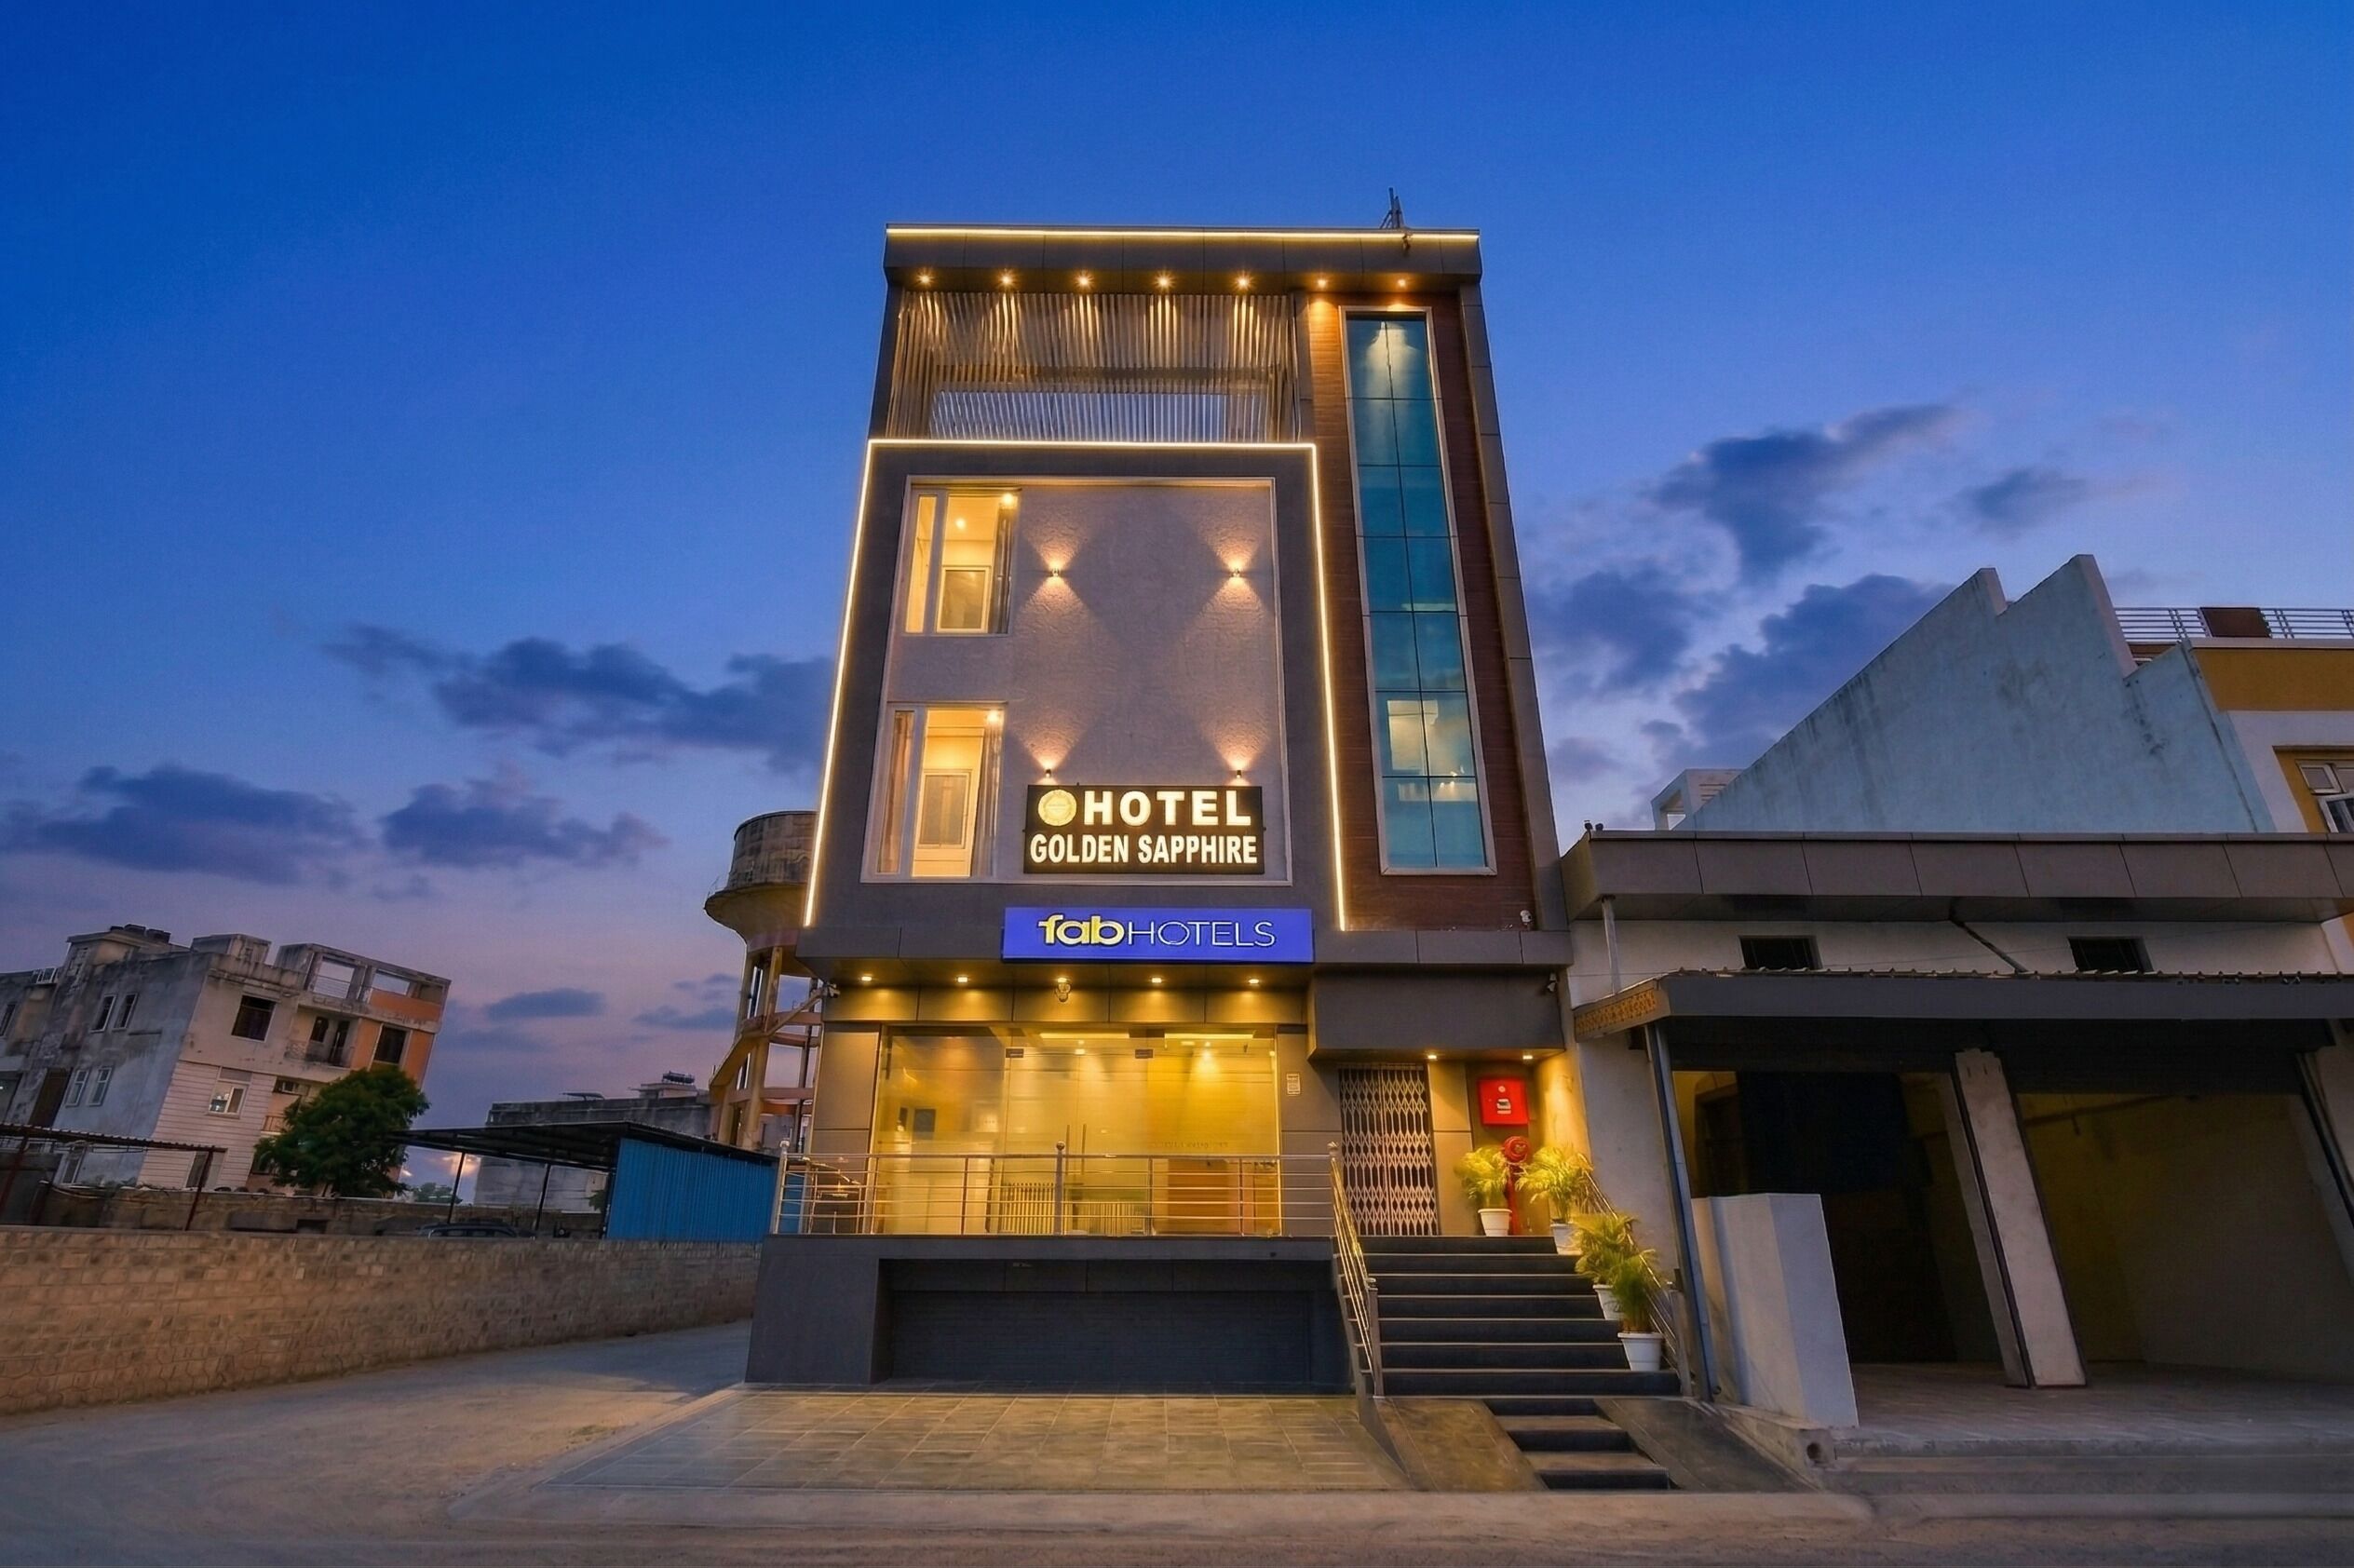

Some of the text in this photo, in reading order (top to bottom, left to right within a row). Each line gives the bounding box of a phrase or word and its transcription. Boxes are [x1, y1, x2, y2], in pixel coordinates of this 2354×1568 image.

[1083, 790, 1251, 827] HOTEL
[1030, 833, 1257, 864] GOLDEN SAPPHIRE
